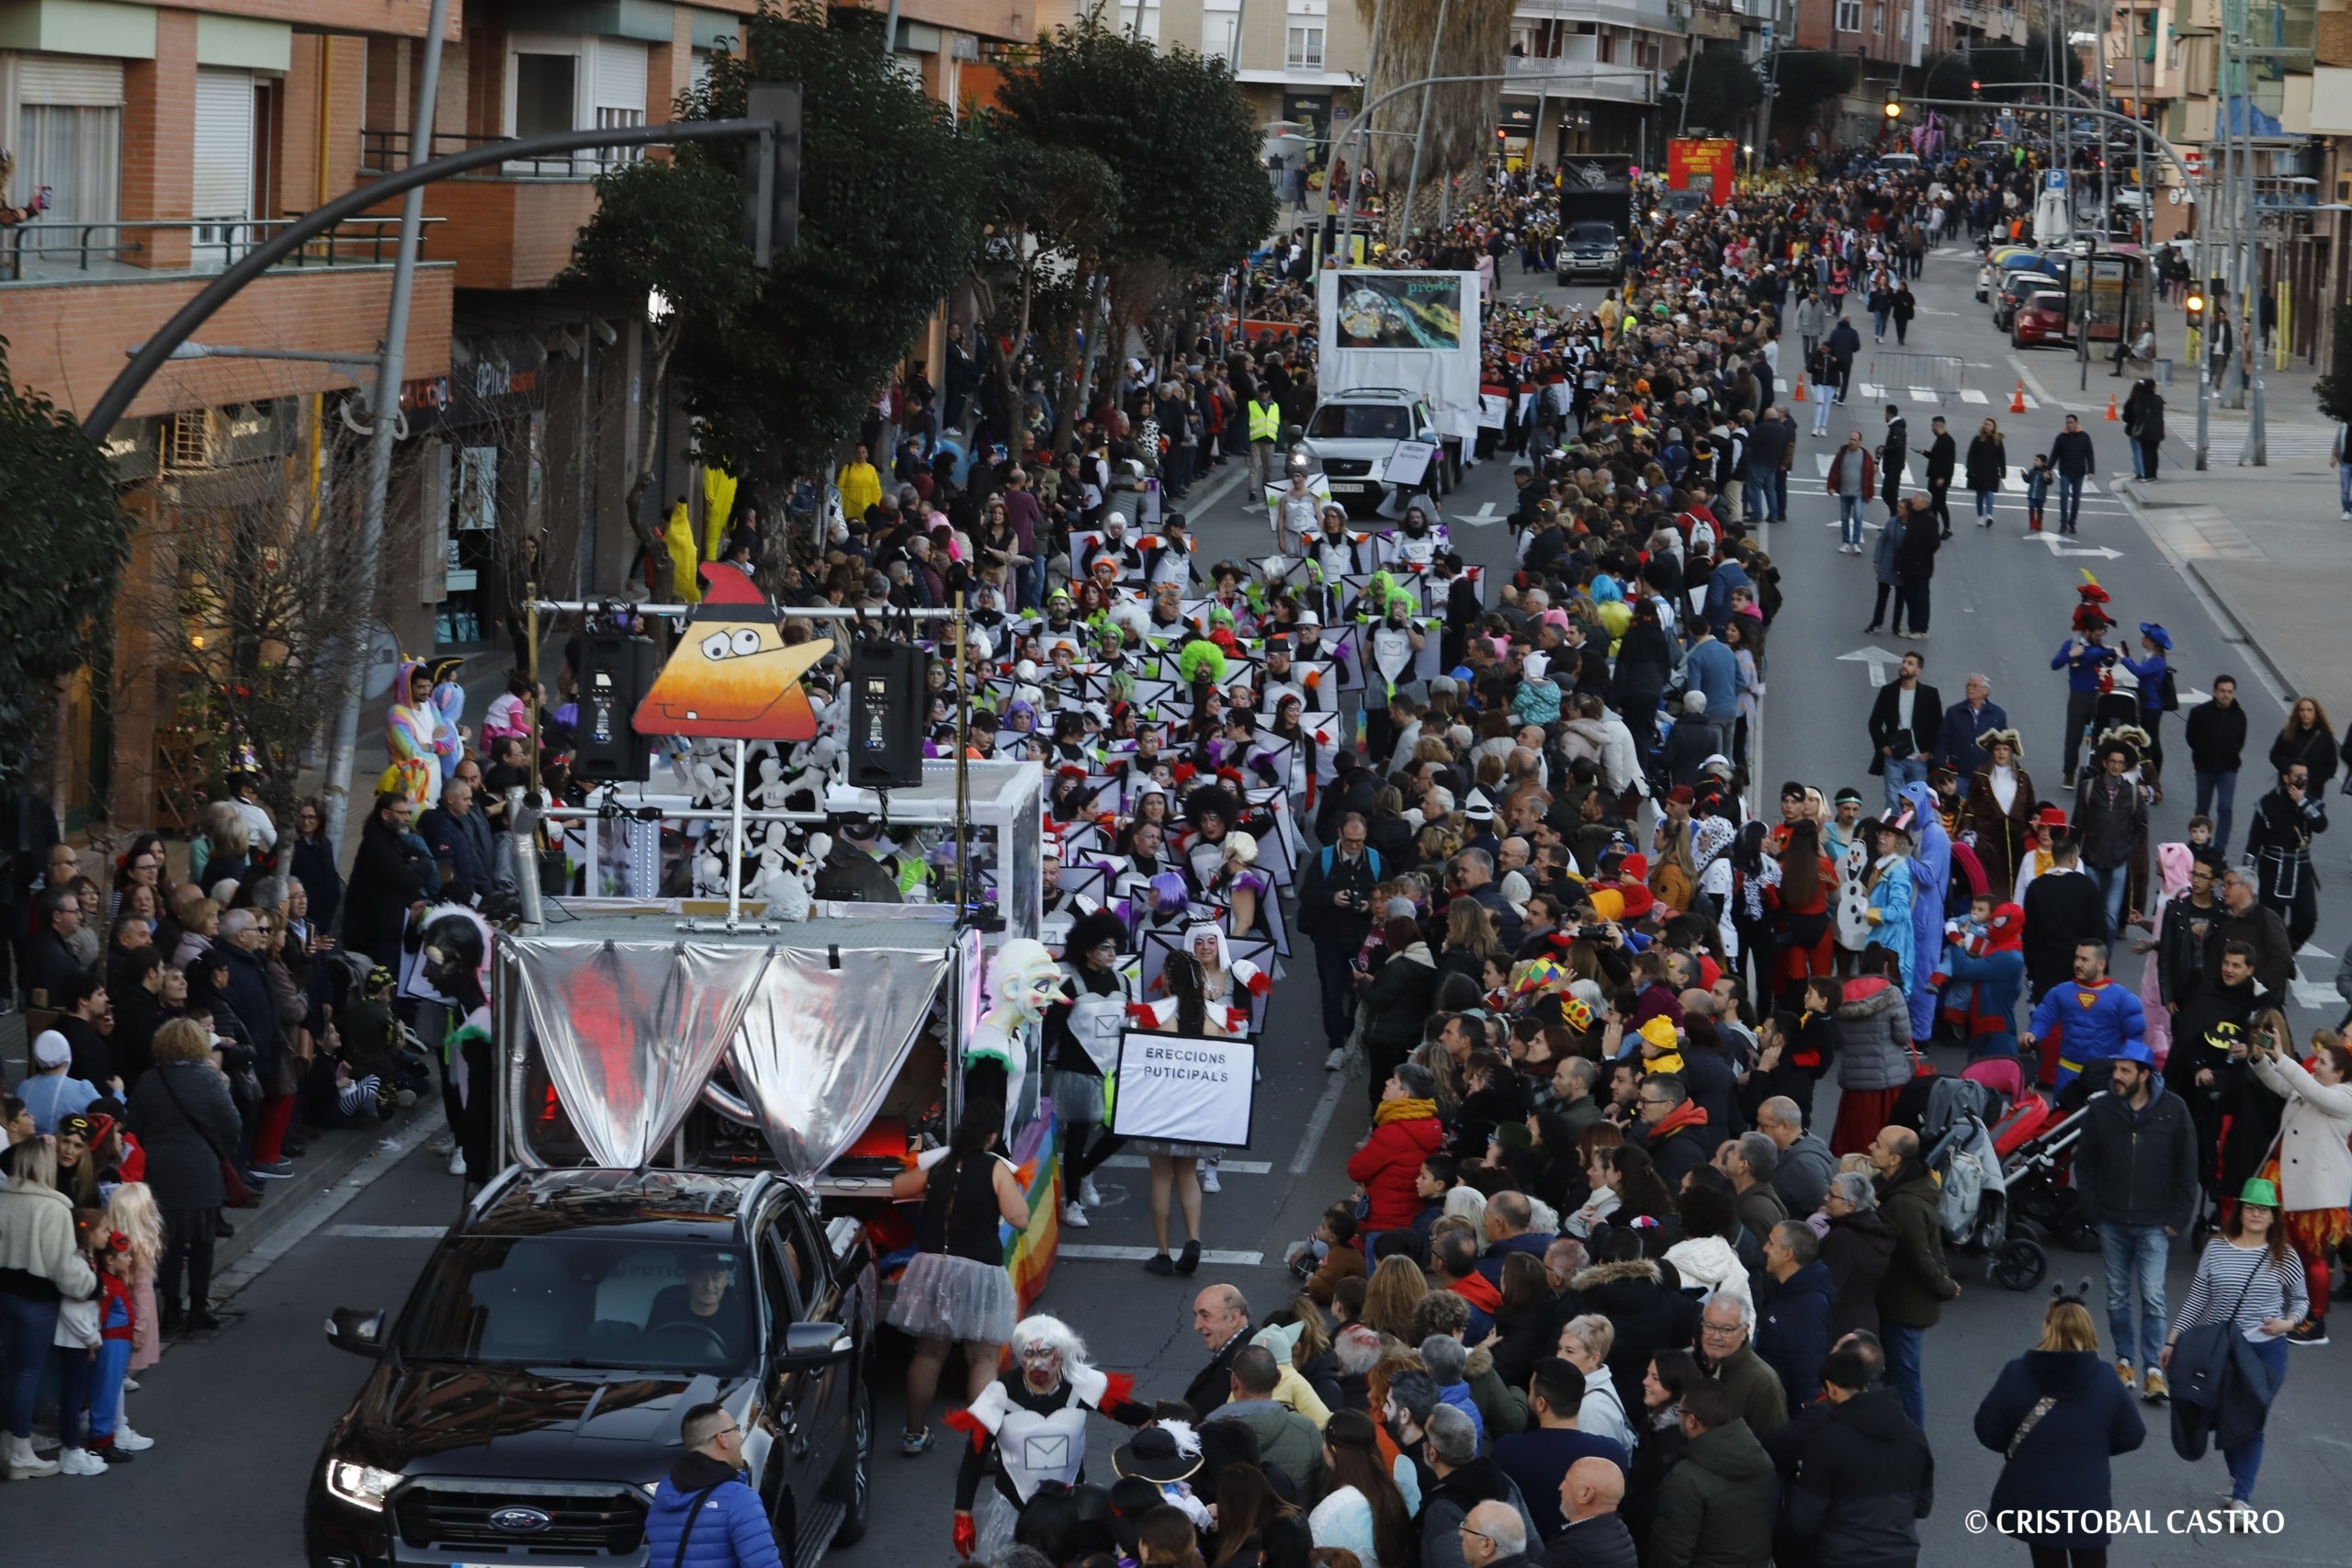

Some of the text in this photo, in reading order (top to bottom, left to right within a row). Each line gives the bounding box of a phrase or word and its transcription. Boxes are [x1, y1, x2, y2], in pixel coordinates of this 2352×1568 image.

[2051, 172, 2062, 186] P
[1146, 1047, 1226, 1064] ERECCIONS
[1144, 1066, 1228, 1082] PUTICIPALS
[433, 1482, 610, 1496] RANGER
[503, 1512, 536, 1526] Ford
